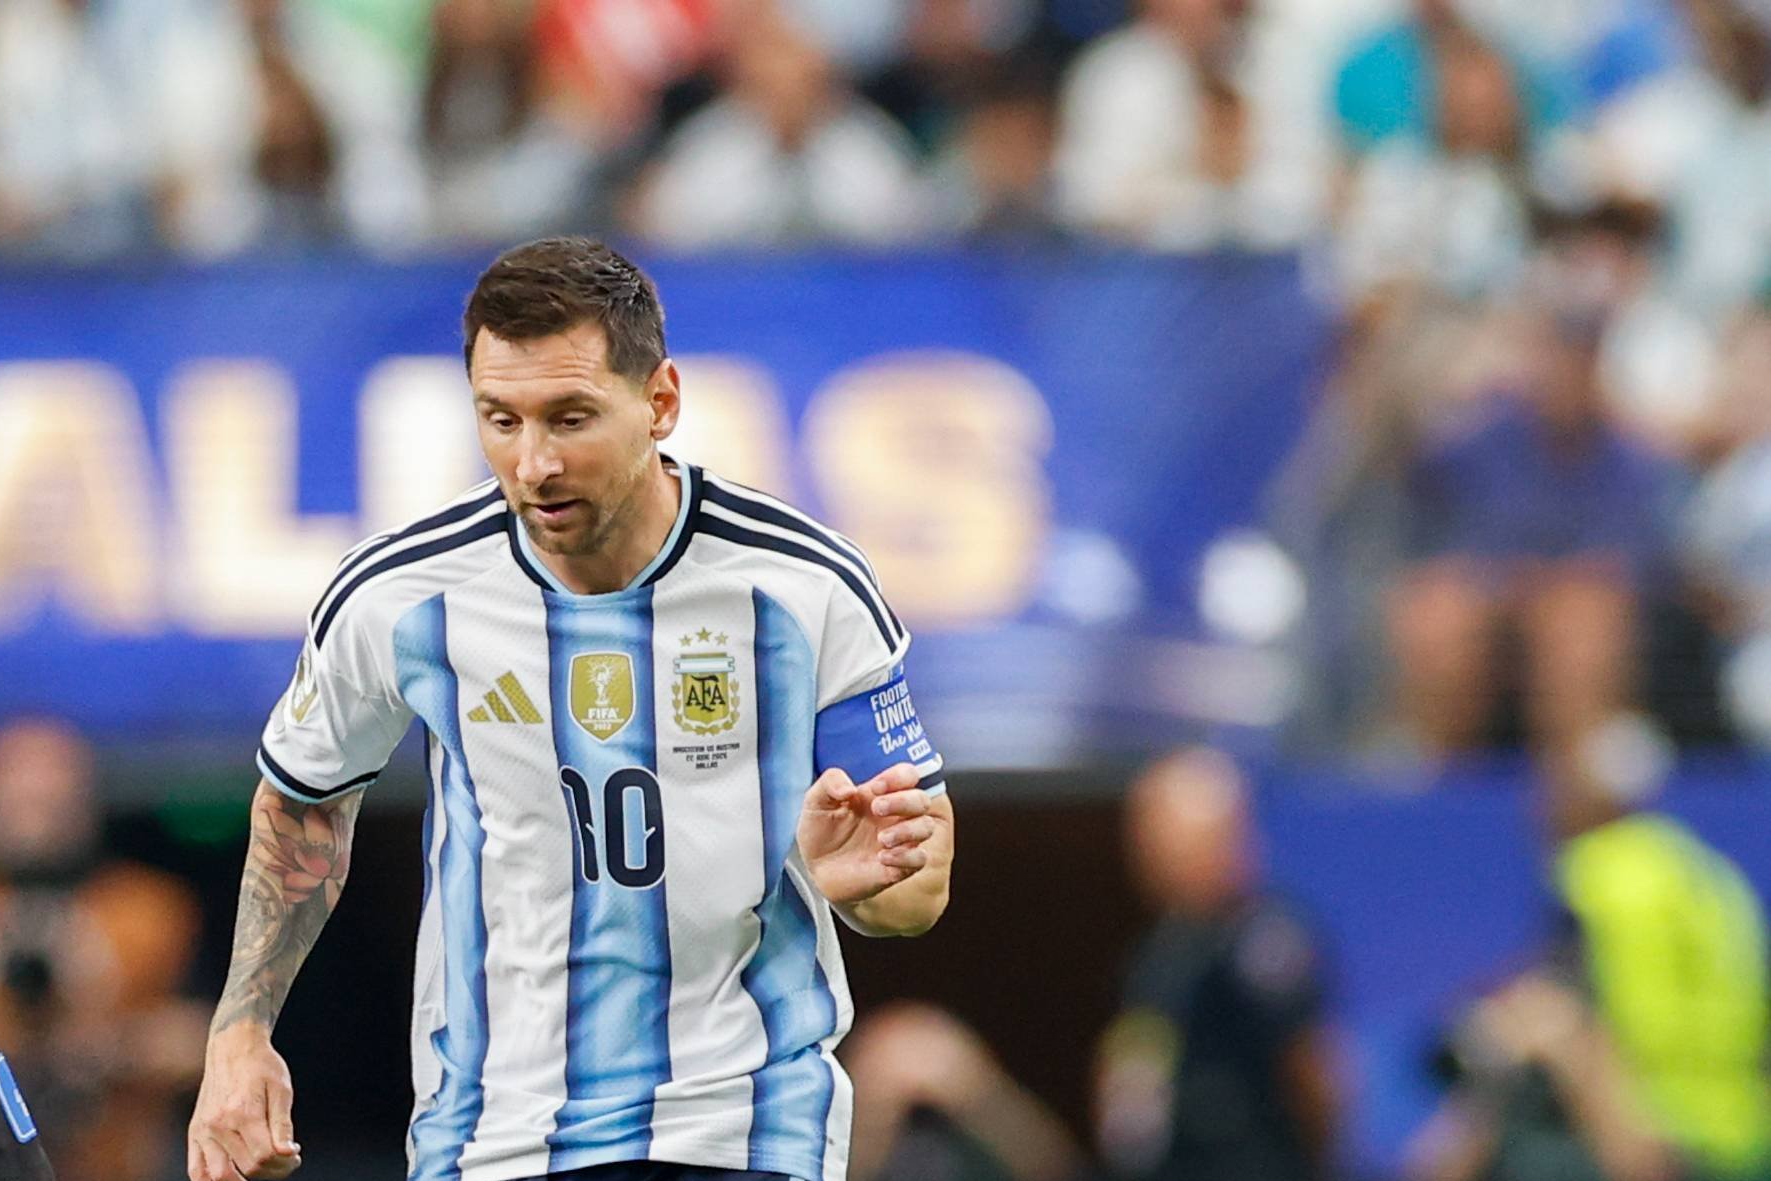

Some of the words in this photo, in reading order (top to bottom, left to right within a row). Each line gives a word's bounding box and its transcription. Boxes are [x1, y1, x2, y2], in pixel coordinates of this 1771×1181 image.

[686, 675, 726, 713] AFA
[588, 707, 618, 719] FIFA
[877, 732, 907, 755] the
[560, 767, 665, 888] 10
